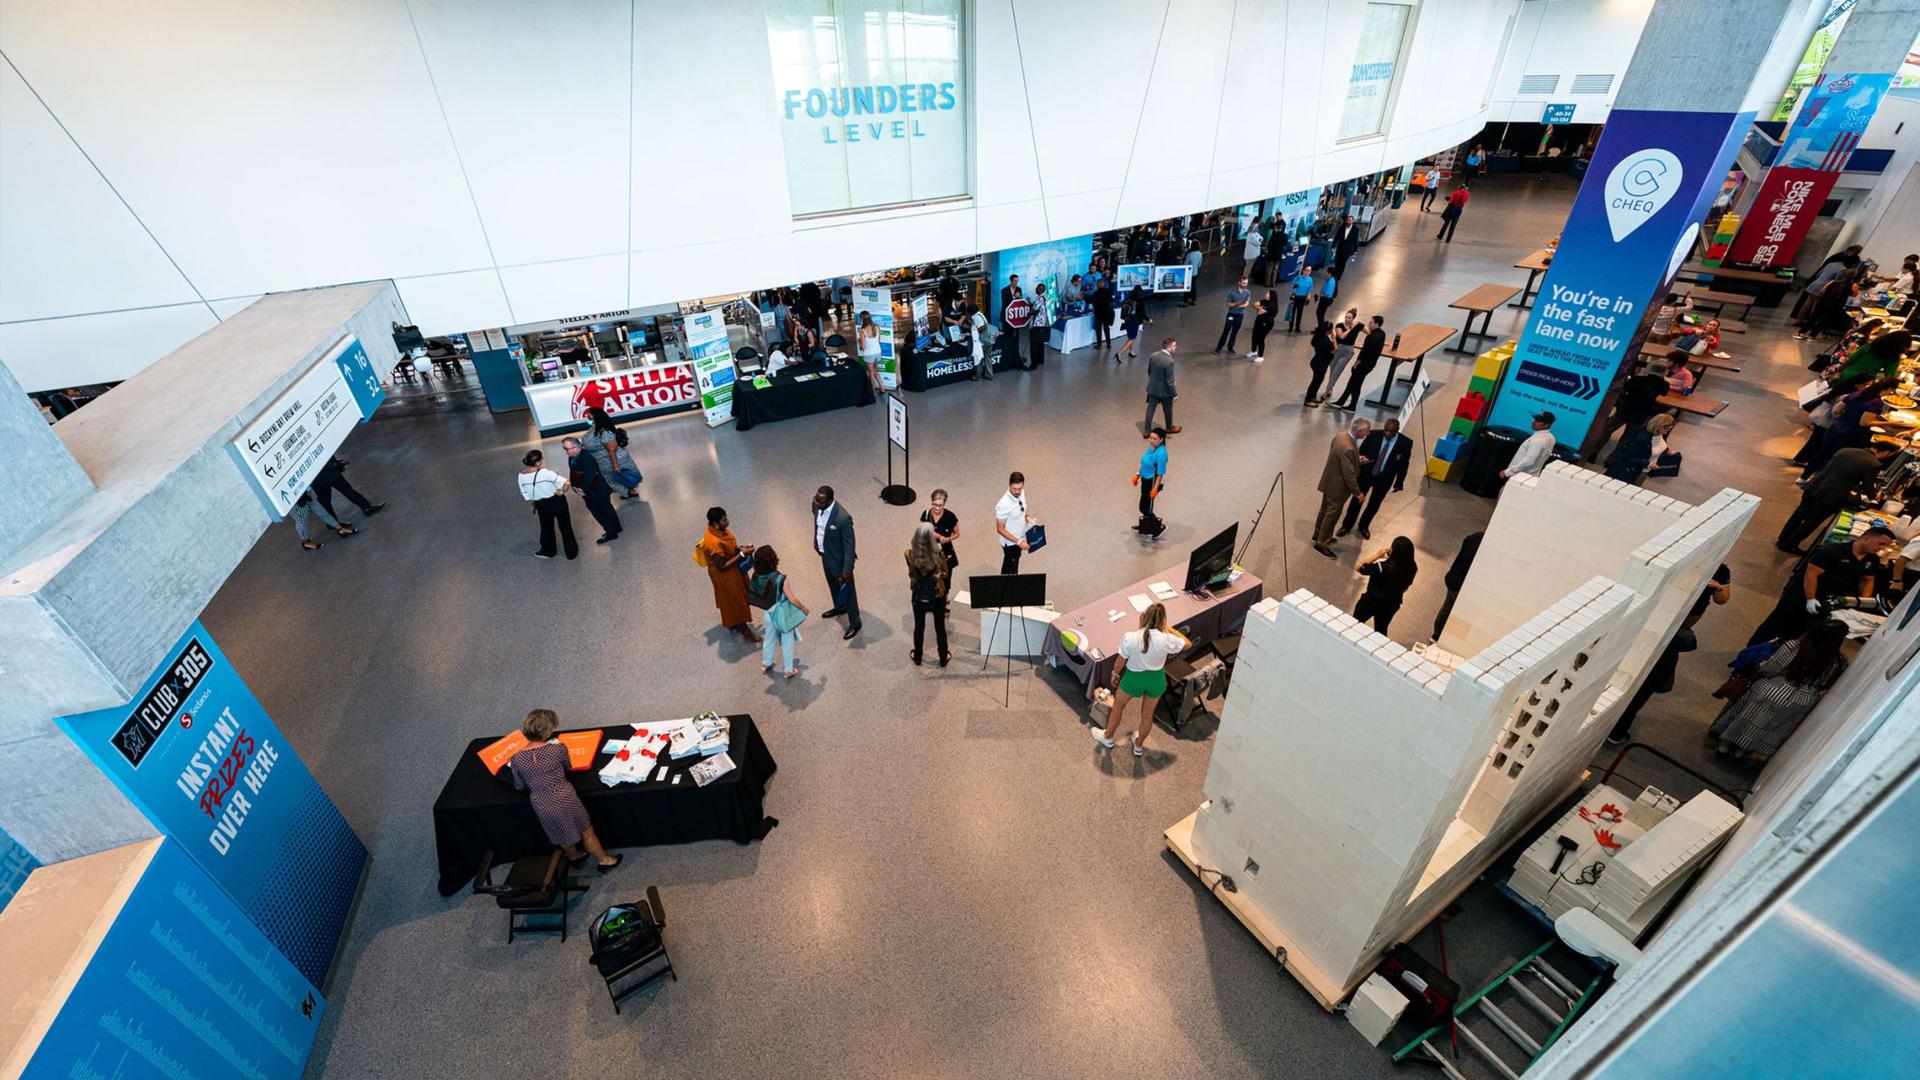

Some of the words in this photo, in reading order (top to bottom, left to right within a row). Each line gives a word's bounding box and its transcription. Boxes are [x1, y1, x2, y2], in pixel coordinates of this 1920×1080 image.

[784, 82, 956, 119] FOUNDERS
[823, 120, 926, 144] LEVEL
[1612, 198, 1654, 213] CHEQ
[1790, 181, 1816, 212] NIKE
[1764, 181, 1804, 242] CONNECT
[1774, 214, 1797, 241] MLB
[1763, 244, 1779, 265] CIT
[1552, 284, 1610, 310] You're
[1612, 296, 1633, 315] in
[559, 315, 590, 324] STELLA
[599, 309, 630, 318] ARTOIS
[1009, 306, 1030, 319] STOP
[1542, 303, 1573, 322] the
[1576, 309, 1615, 332] fast
[1535, 319, 1574, 341] lane
[1576, 332, 1620, 352] now
[354, 351, 368, 370] 16
[1528, 343, 1549, 353] ORDER
[1549, 348, 1571, 357] AHEAD
[1571, 352, 1591, 361] FROM
[1590, 357, 1610, 367] YOUR
[1542, 351, 1559, 359] WITH
[1560, 355, 1572, 363] THE
[1572, 358, 1592, 369] CHEQ
[595, 365, 692, 394] STELLA
[926, 361, 974, 379] HOMELESS
[1520, 368, 1538, 377] ORDER
[1560, 379, 1576, 388] HERE
[365, 376, 380, 397] 32
[603, 381, 697, 413] ARTOIS
[1510, 389, 1522, 398] Skip
[276, 416, 285, 428] BAY
[283, 407, 295, 422] BREW
[141, 684, 179, 731] CLUB
[175, 645, 208, 689] 305
[176, 706, 241, 801] INSTANT
[200, 728, 255, 819] PRIZES
[209, 790, 252, 856] OVER
[243, 740, 279, 795] HERE
